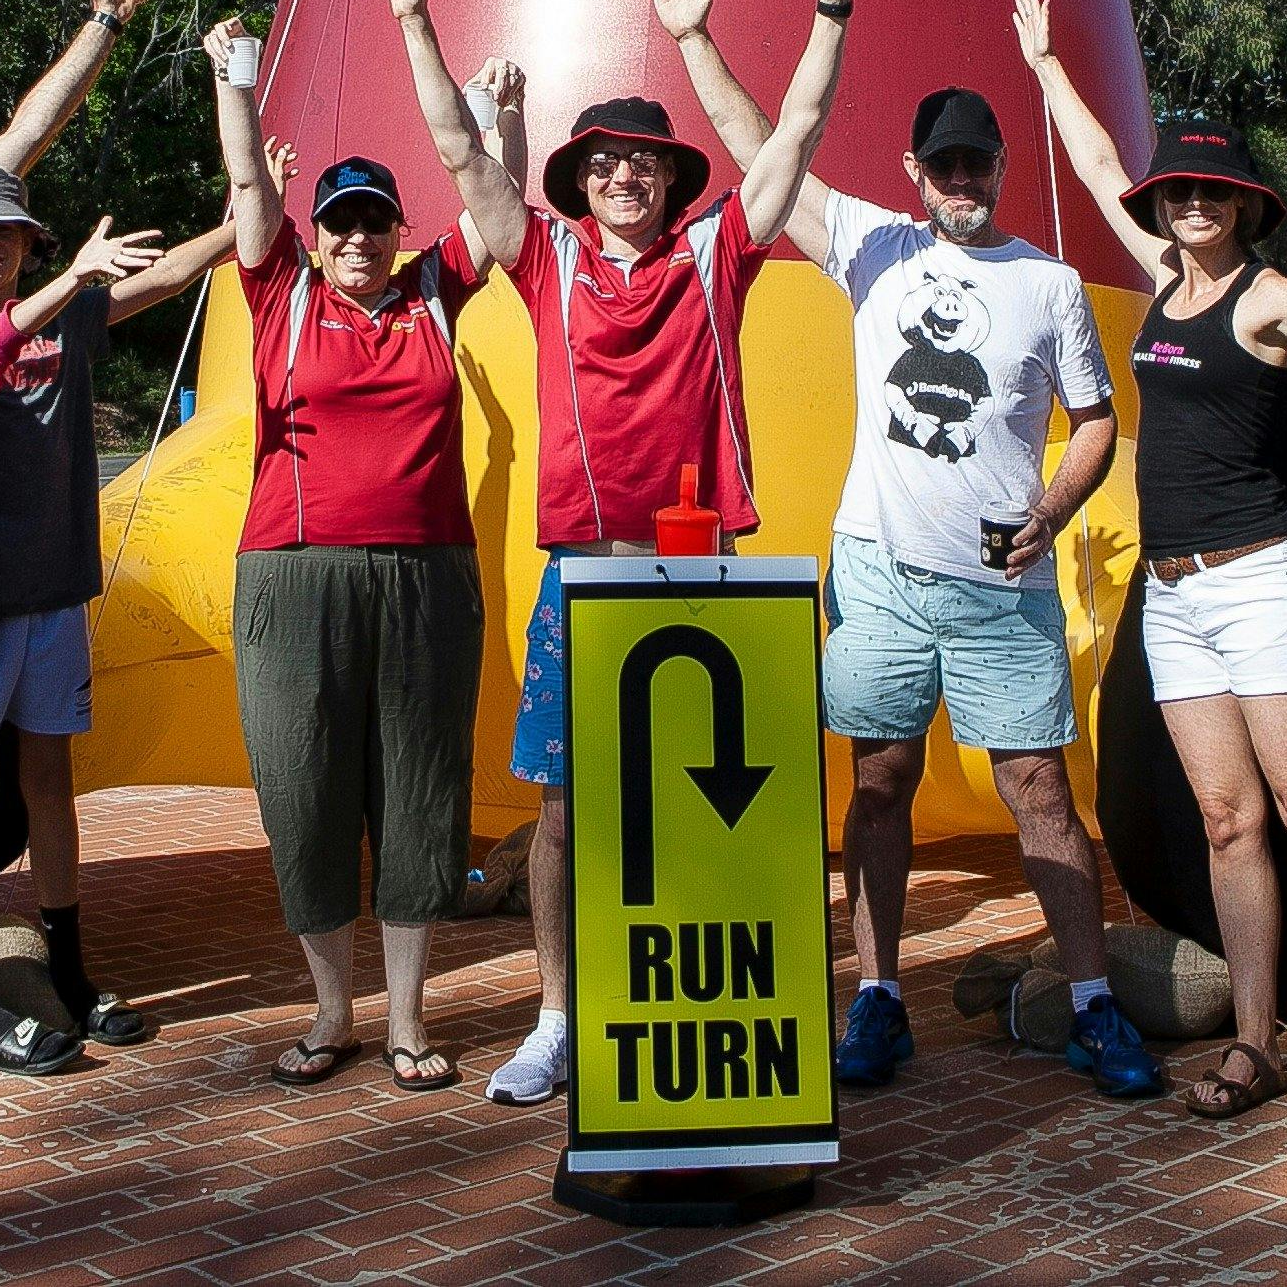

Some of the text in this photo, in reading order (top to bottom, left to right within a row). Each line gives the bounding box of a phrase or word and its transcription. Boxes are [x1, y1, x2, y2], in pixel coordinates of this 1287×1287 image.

[337, 171, 372, 181] RURAL
[337, 177, 366, 188] BANK
[1150, 341, 1185, 355] ReBorn
[1169, 355, 1202, 369] FITNESS
[918, 381, 959, 399] Bendigo
[628, 920, 775, 1003] RUN
[605, 1017, 800, 1104] TURN
